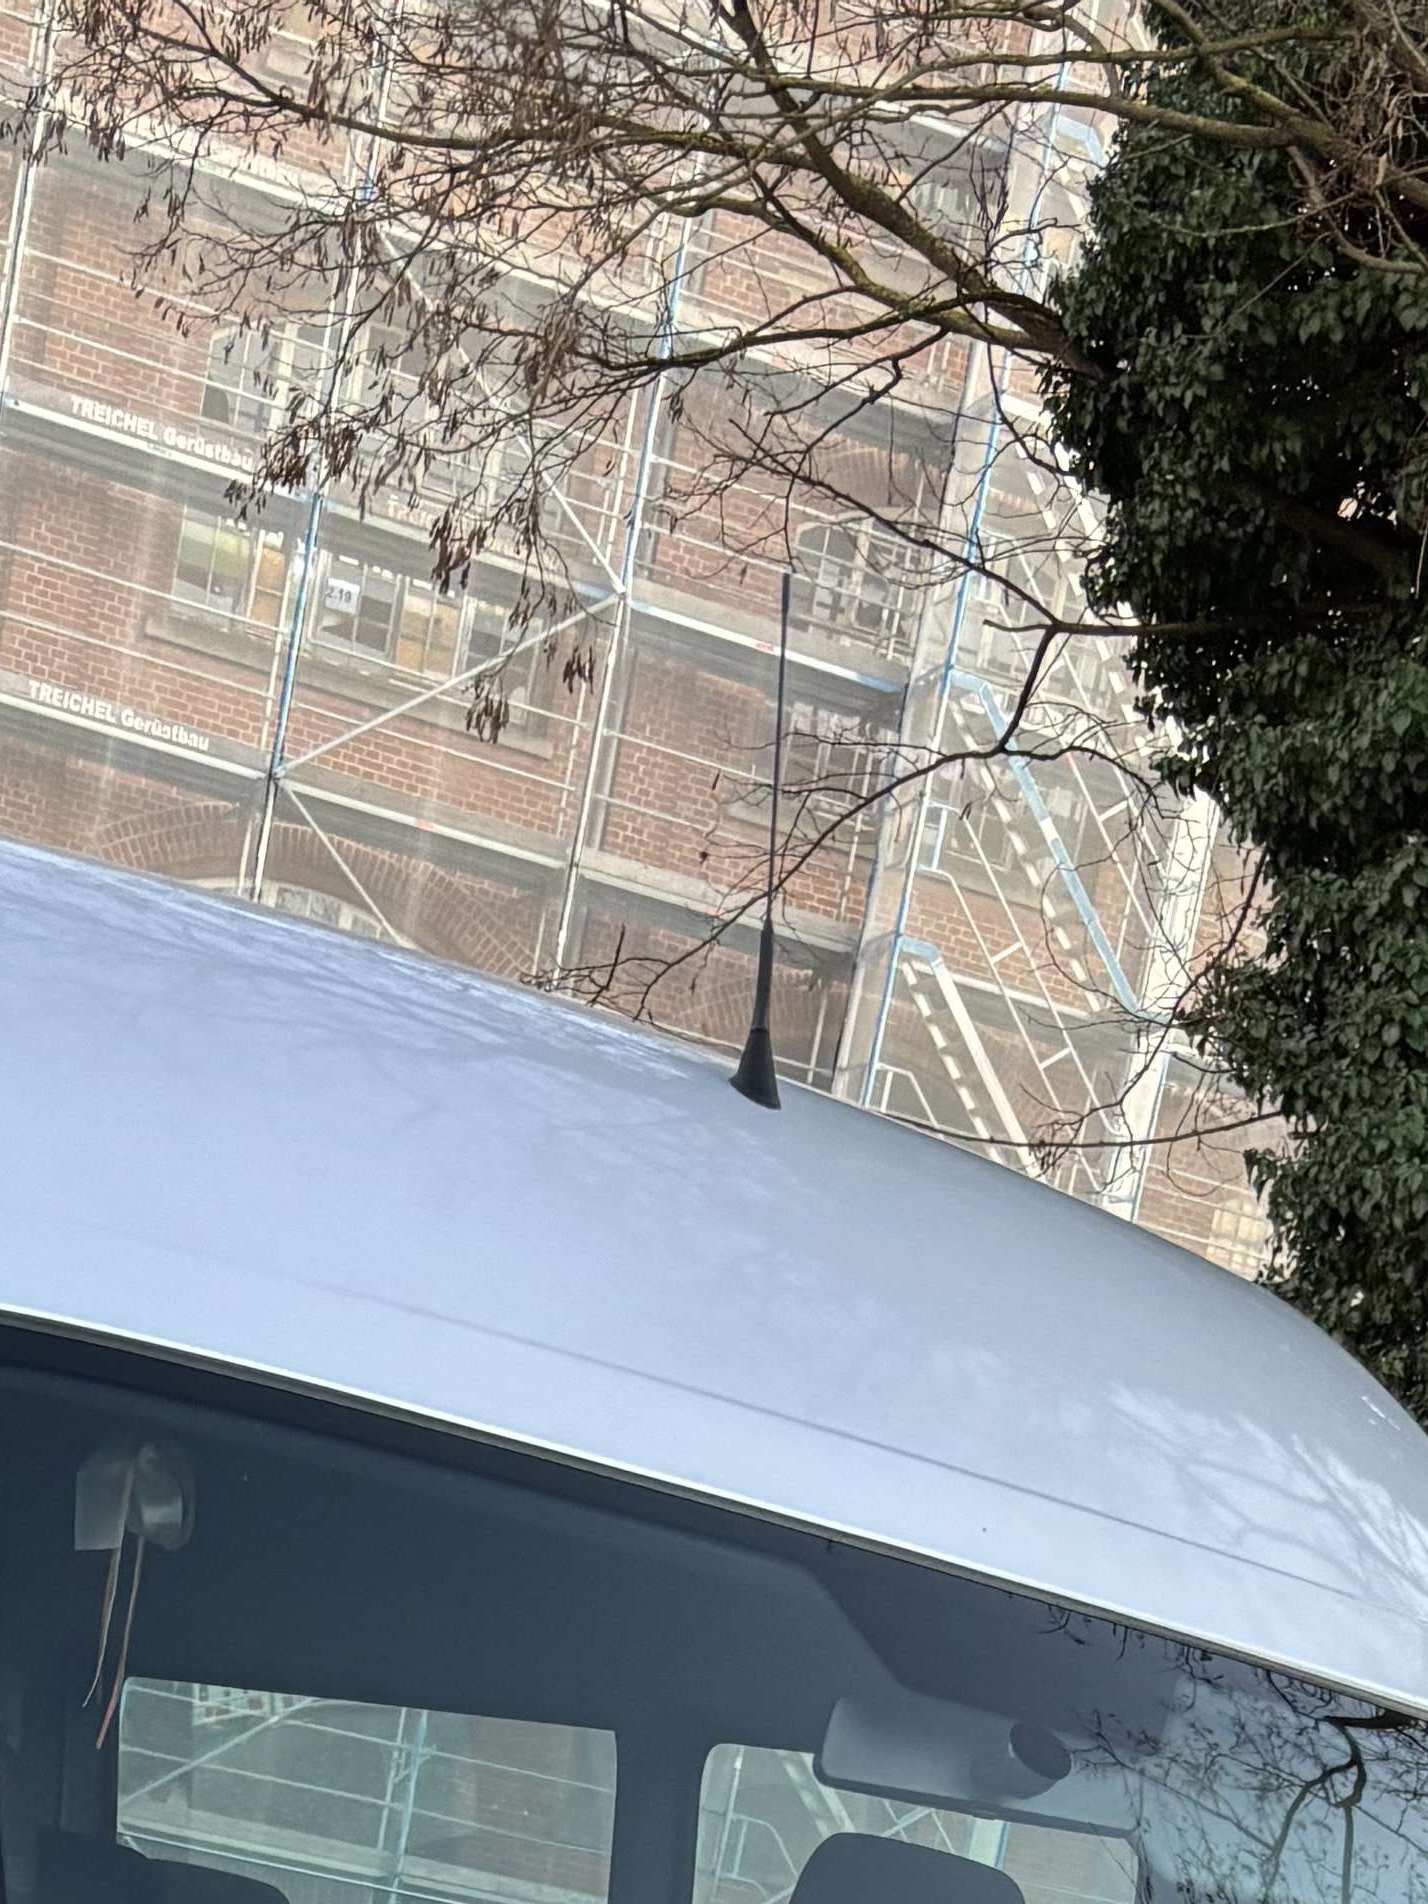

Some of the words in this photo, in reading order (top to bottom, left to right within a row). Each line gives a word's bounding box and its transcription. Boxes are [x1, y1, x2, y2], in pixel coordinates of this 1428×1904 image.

[69, 393, 159, 441] TREICHEL
[162, 426, 254, 472] Gerüstbau
[28, 679, 117, 724] TREICHEL
[120, 707, 210, 751] Gerüstbau
